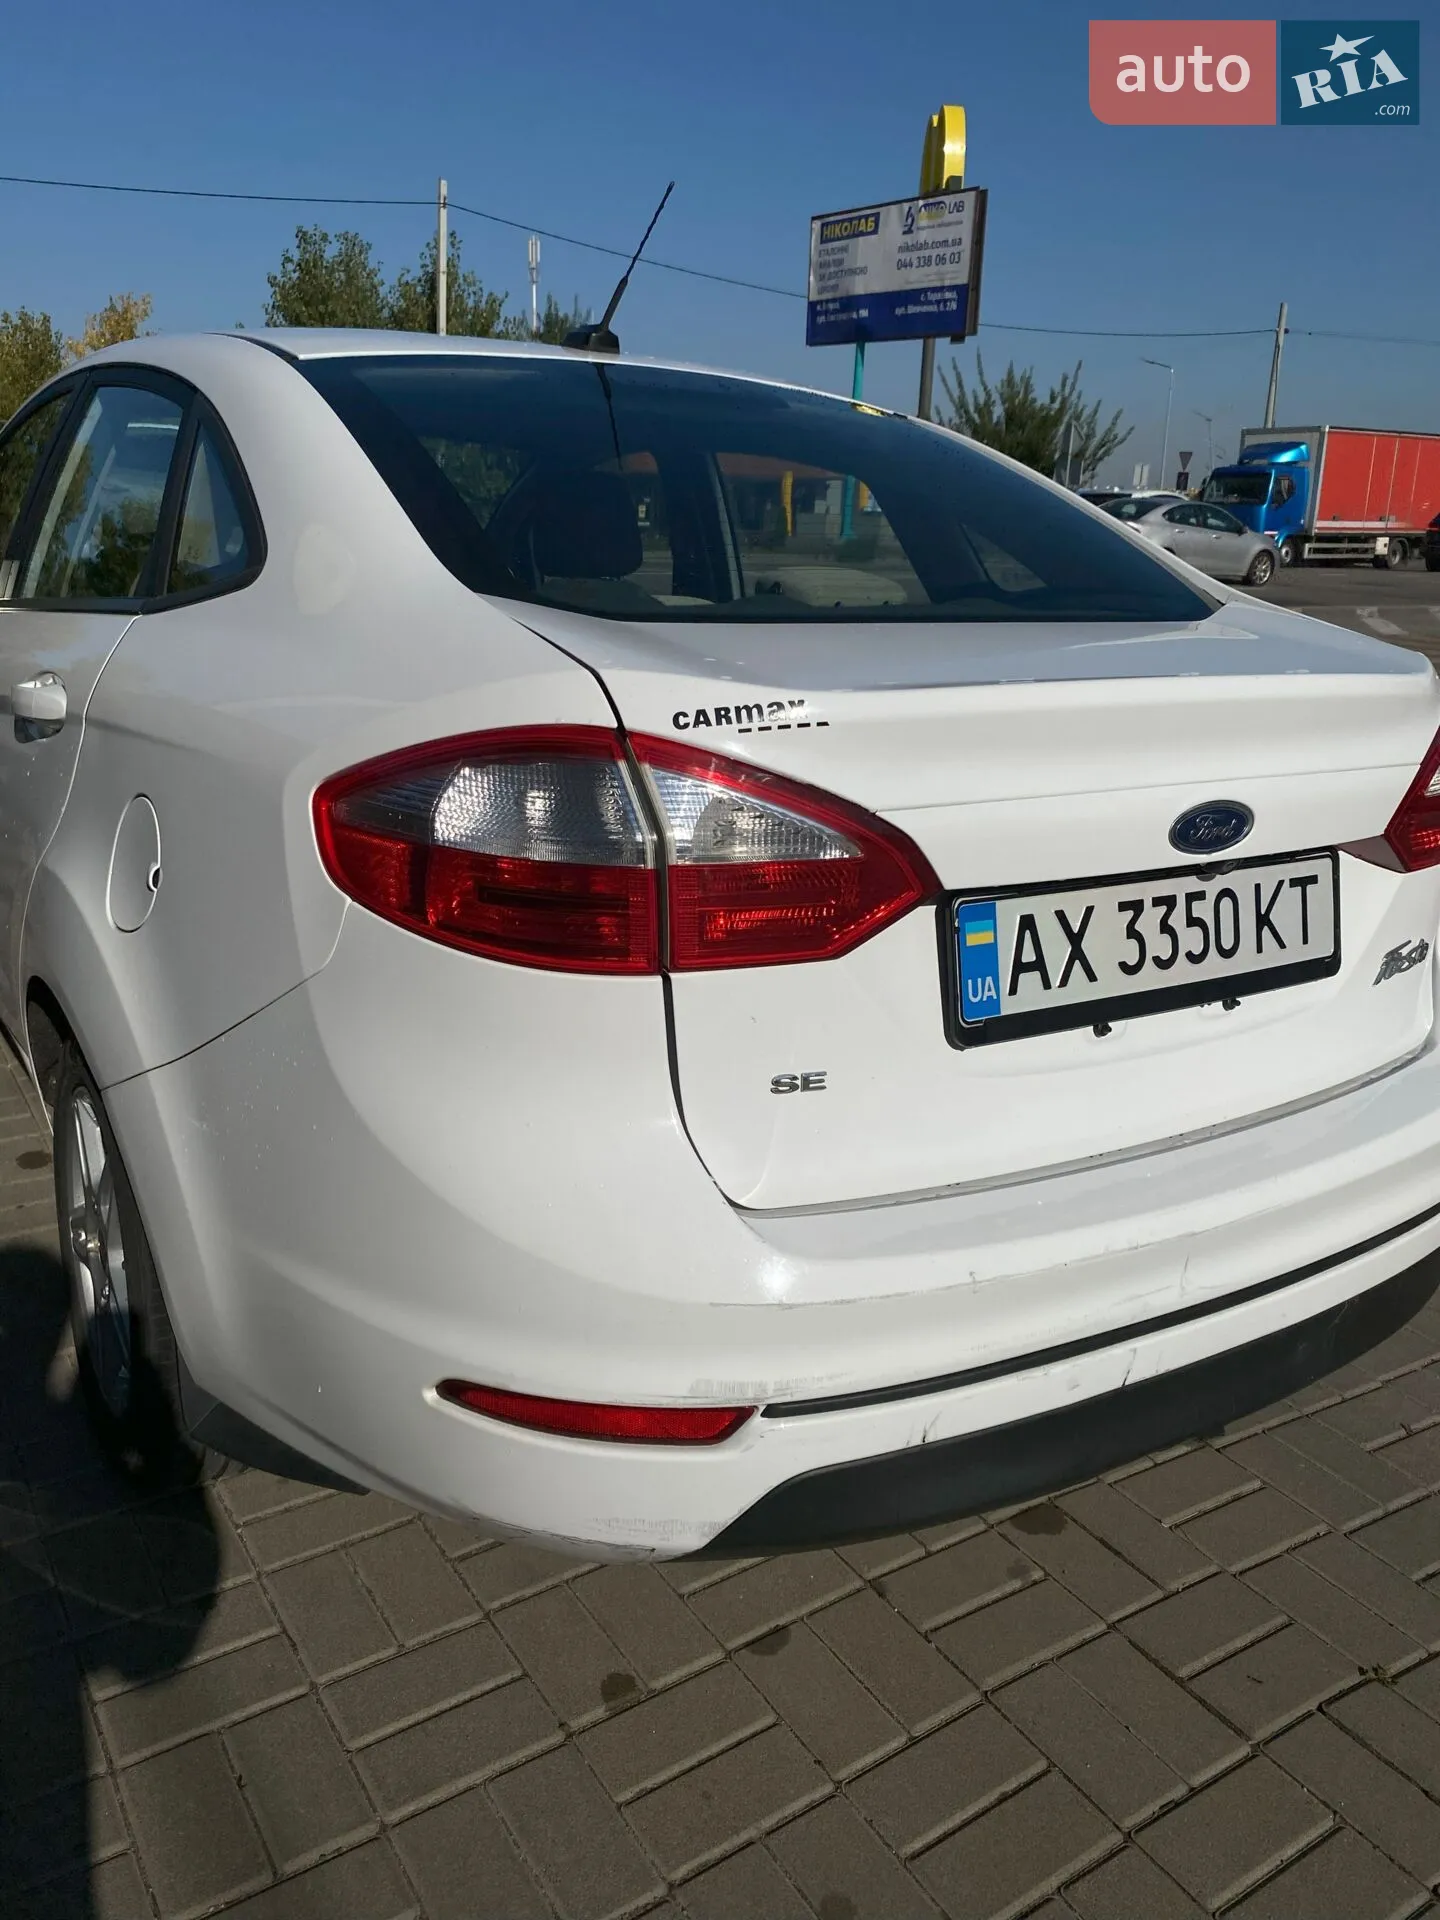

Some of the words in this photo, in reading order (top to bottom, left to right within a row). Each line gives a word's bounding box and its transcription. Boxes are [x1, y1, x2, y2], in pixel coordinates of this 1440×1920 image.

[948, 201, 965, 214] LAB
[822, 216, 876, 240] НІКОЛАБ
[897, 238, 962, 254] nikolab.com.ua
[896, 258, 913, 271] 044
[915, 255, 933, 268] 338
[935, 253, 947, 266] 06
[949, 252, 961, 265] 03
[1189, 814, 1238, 848] Ford
[1007, 904, 1099, 998] AX
[1116, 886, 1242, 977] 3350
[1253, 873, 1319, 956] KT
[967, 976, 998, 1004] UA
[769, 1070, 828, 1095] SE
